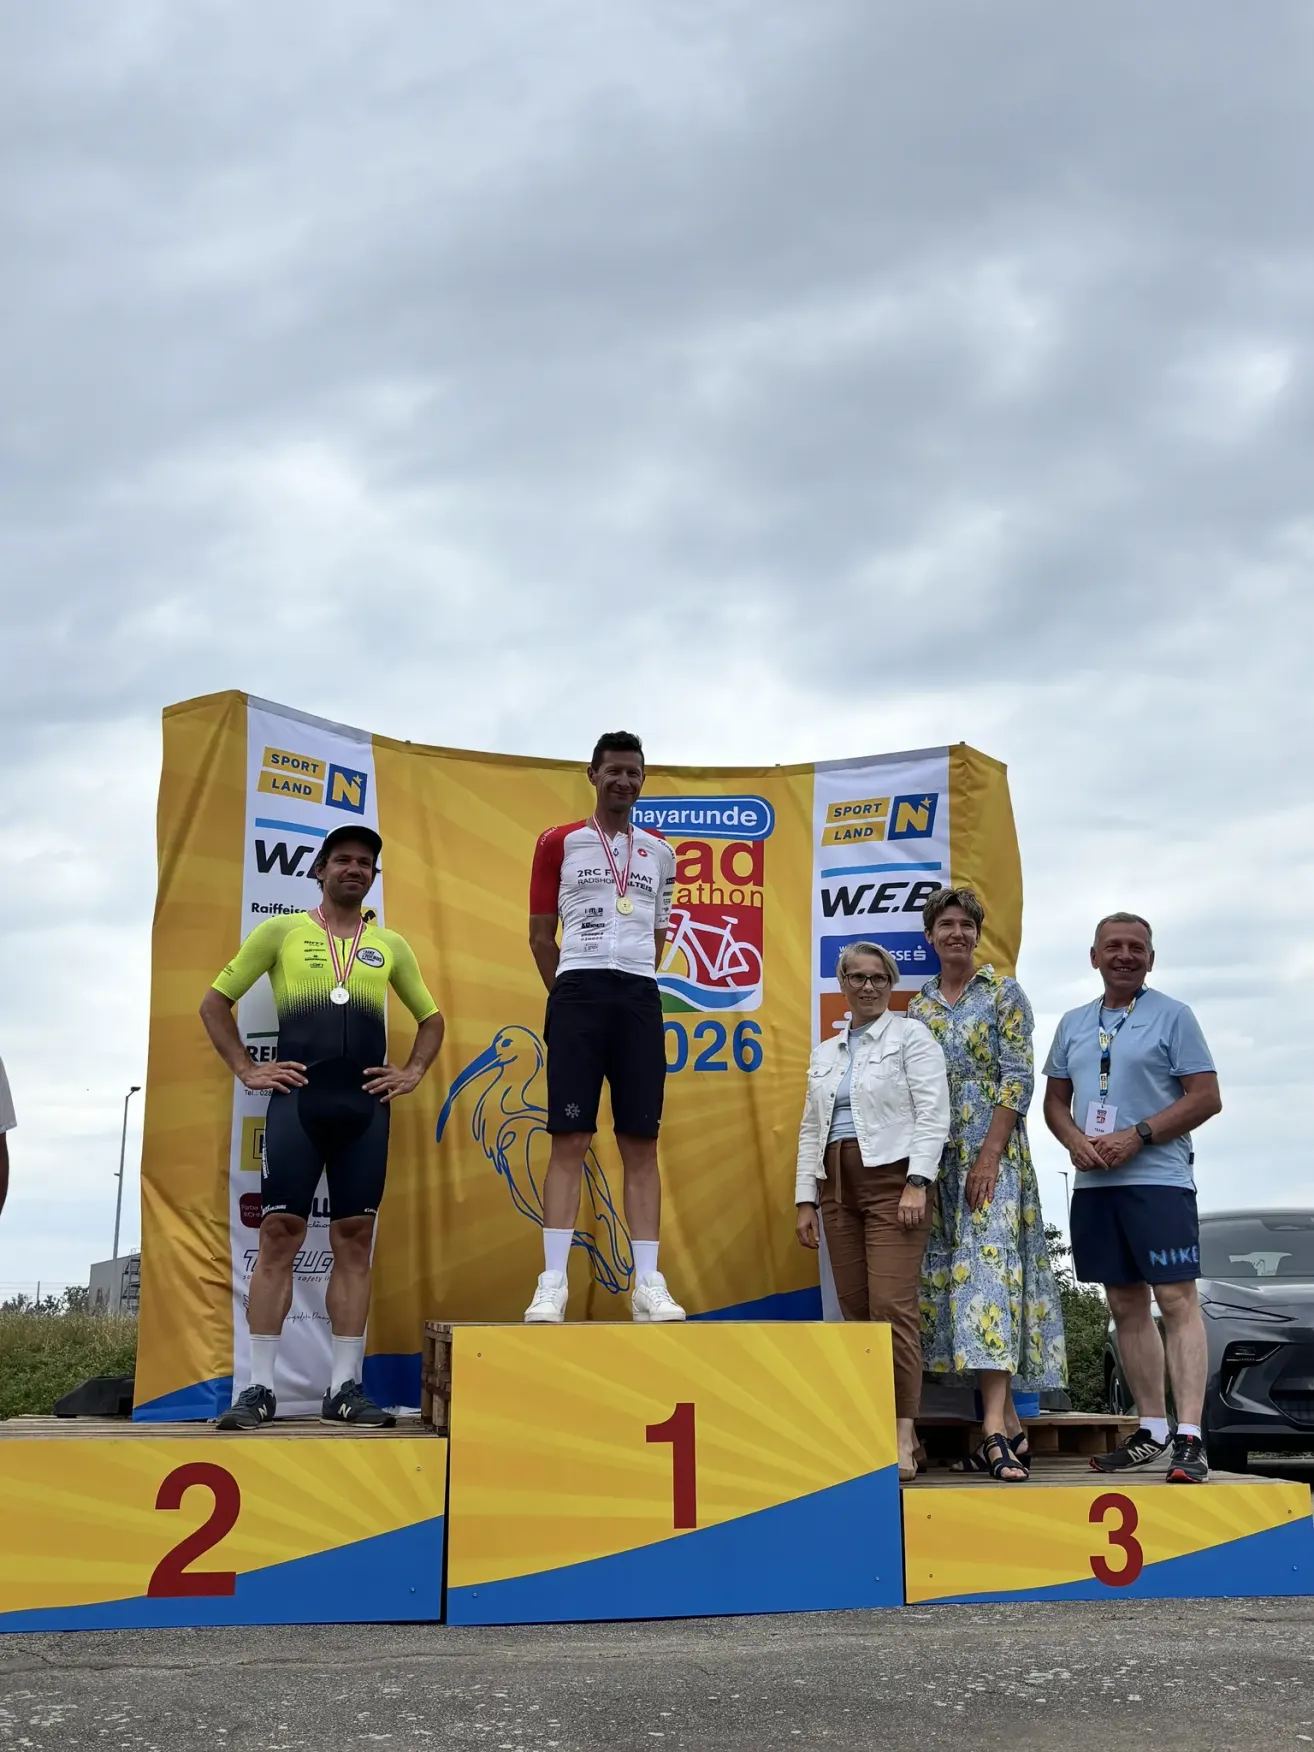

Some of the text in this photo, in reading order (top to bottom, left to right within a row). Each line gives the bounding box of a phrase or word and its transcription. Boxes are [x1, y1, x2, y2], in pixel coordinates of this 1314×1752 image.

[271, 753, 319, 774] SPORT
[271, 778, 312, 796] LAND
[630, 806, 758, 827] hayarunde
[834, 803, 882, 818] SPORT
[834, 827, 874, 840] LAND
[675, 841, 764, 887] ad
[577, 868, 602, 878] 2RC
[605, 868, 653, 884] FMAT
[677, 880, 764, 907] athon
[663, 1020, 763, 1073] 026
[259, 1089, 272, 1097] 028
[646, 1403, 697, 1529] 1
[147, 1462, 241, 1598] 2
[1088, 1493, 1143, 1587] 3
